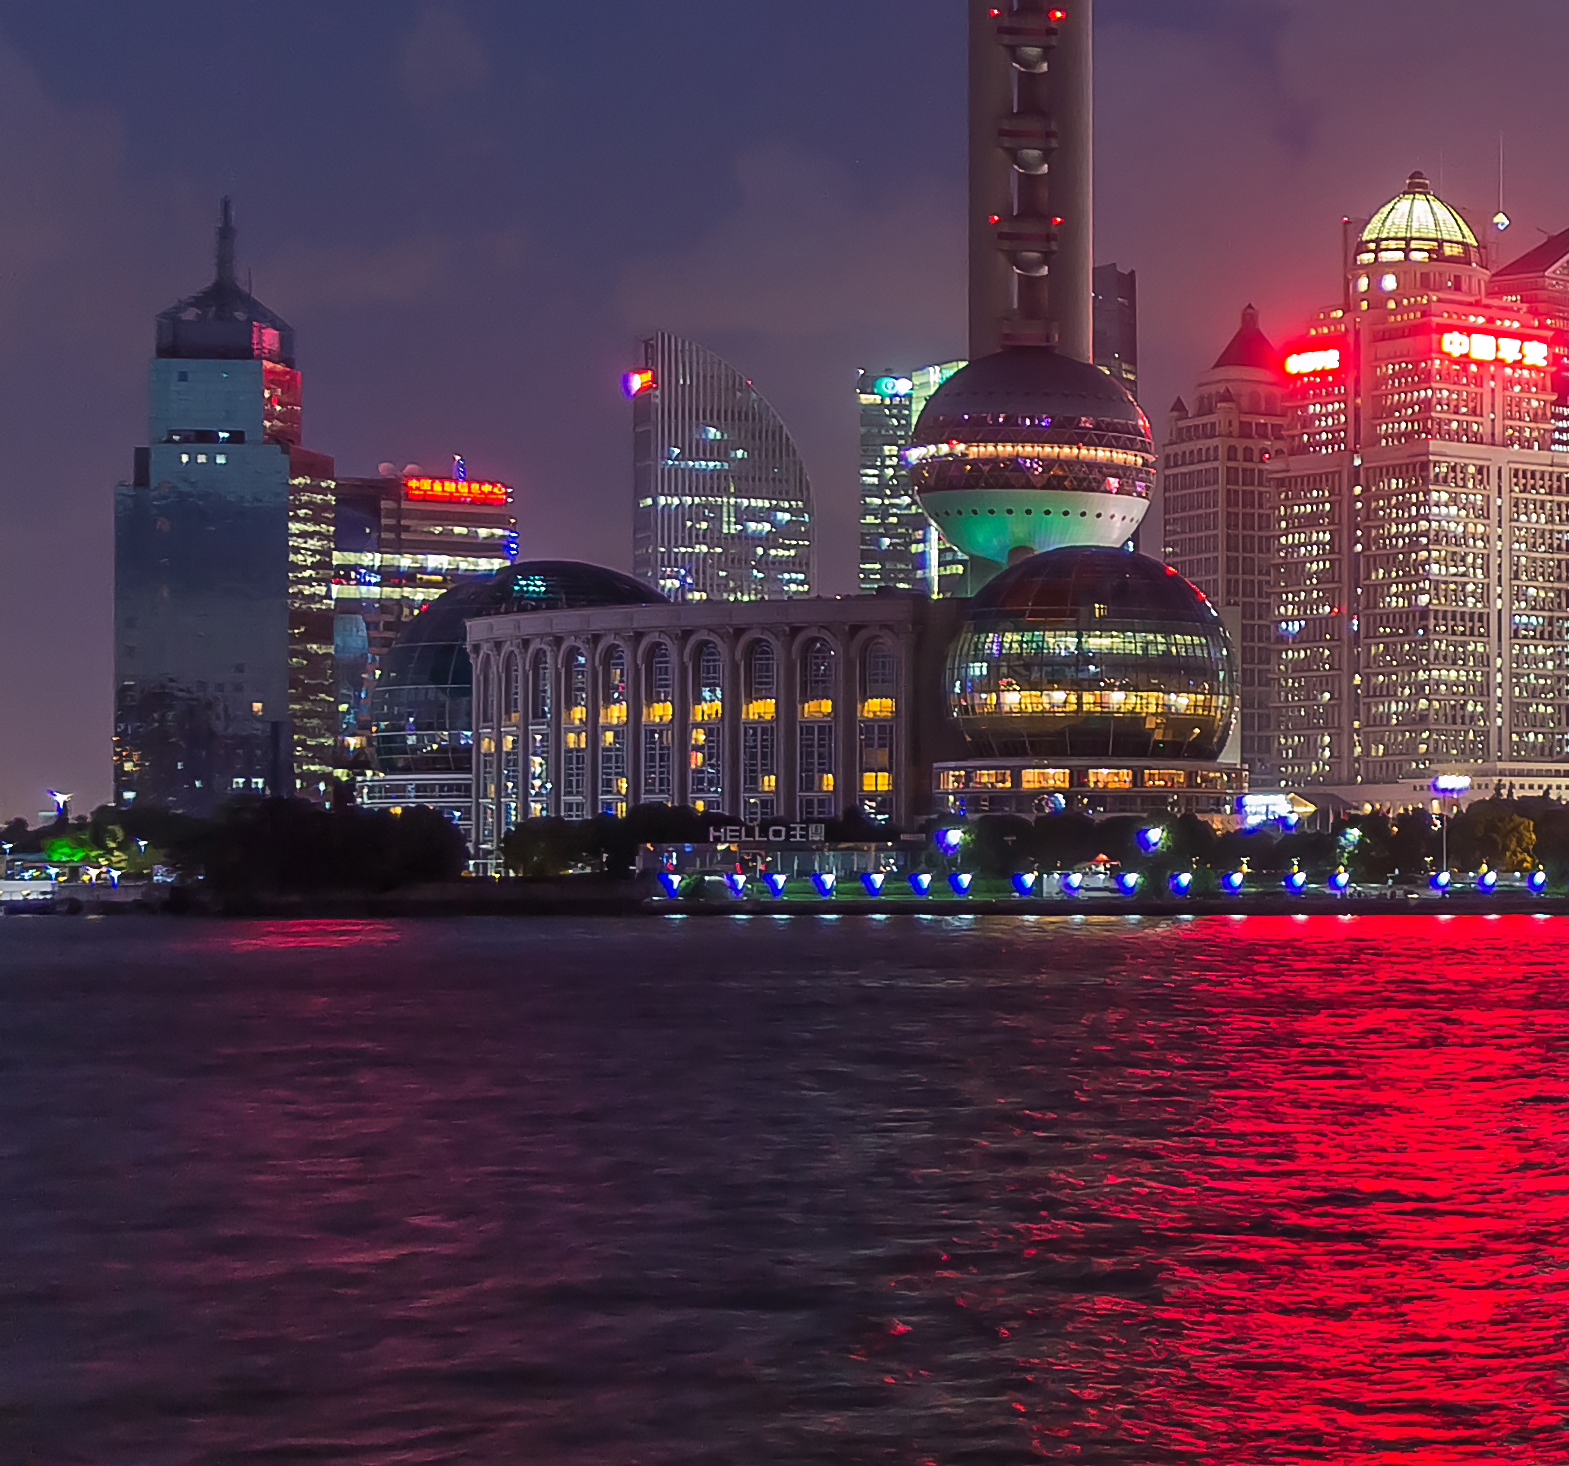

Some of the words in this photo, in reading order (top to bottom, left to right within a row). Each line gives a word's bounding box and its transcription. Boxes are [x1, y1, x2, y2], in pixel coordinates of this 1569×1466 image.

[1441, 330, 1548, 367] 中平安
[709, 826, 786, 842] HELLO
